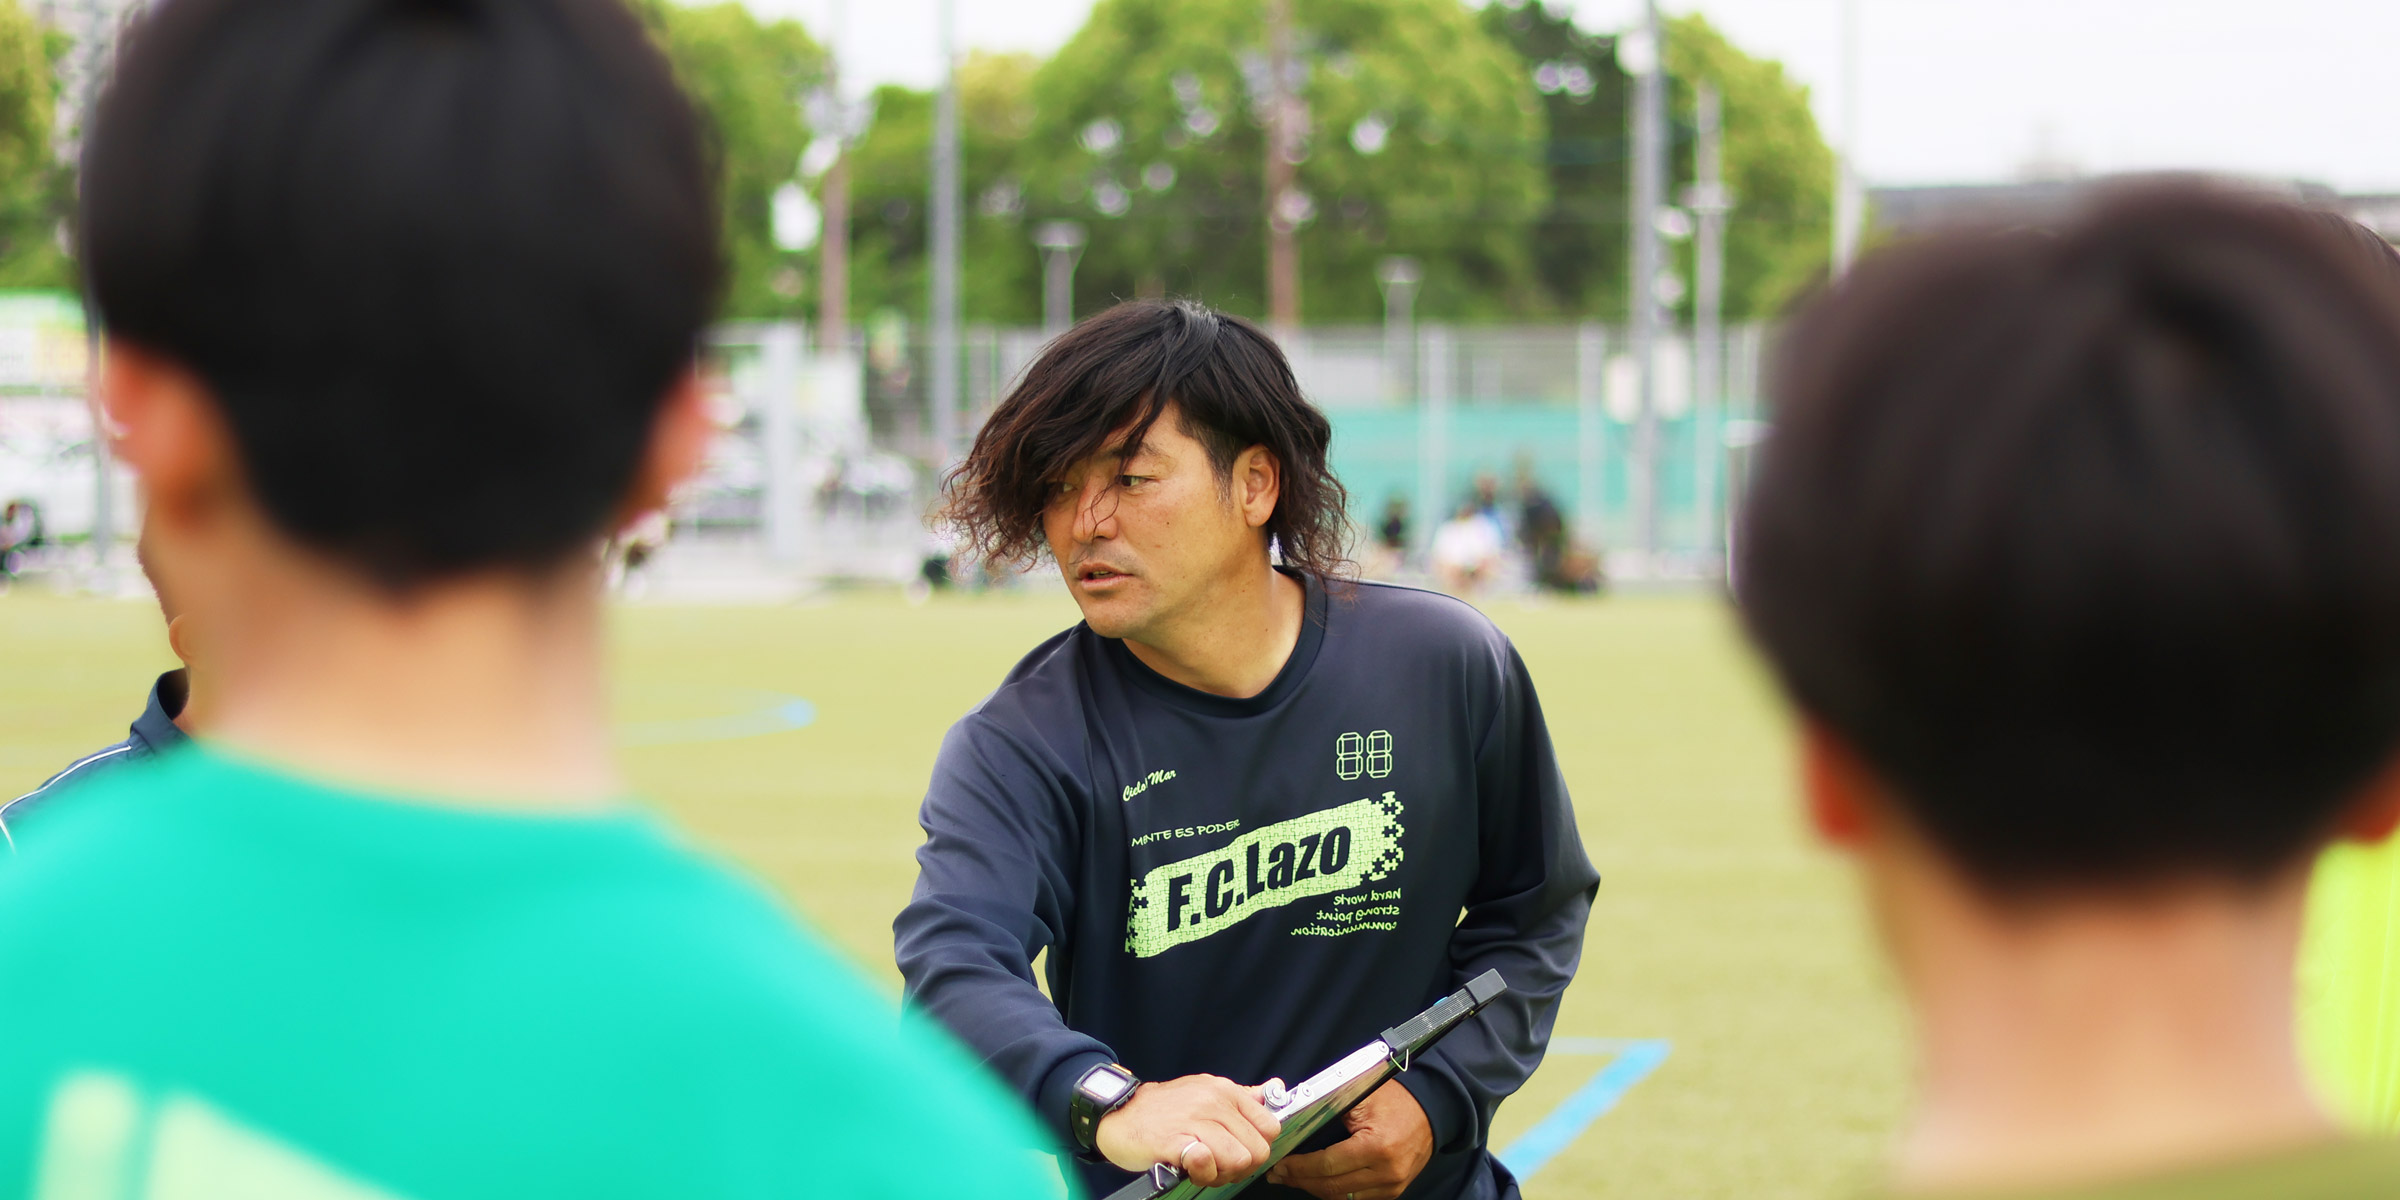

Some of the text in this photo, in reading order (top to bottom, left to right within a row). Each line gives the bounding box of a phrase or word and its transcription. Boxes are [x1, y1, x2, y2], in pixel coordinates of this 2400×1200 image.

[1336, 729, 1393, 781] 88
[1147, 769, 1177, 785] Mar
[1174, 827, 1195, 838] ES
[1196, 818, 1241, 836] PODER
